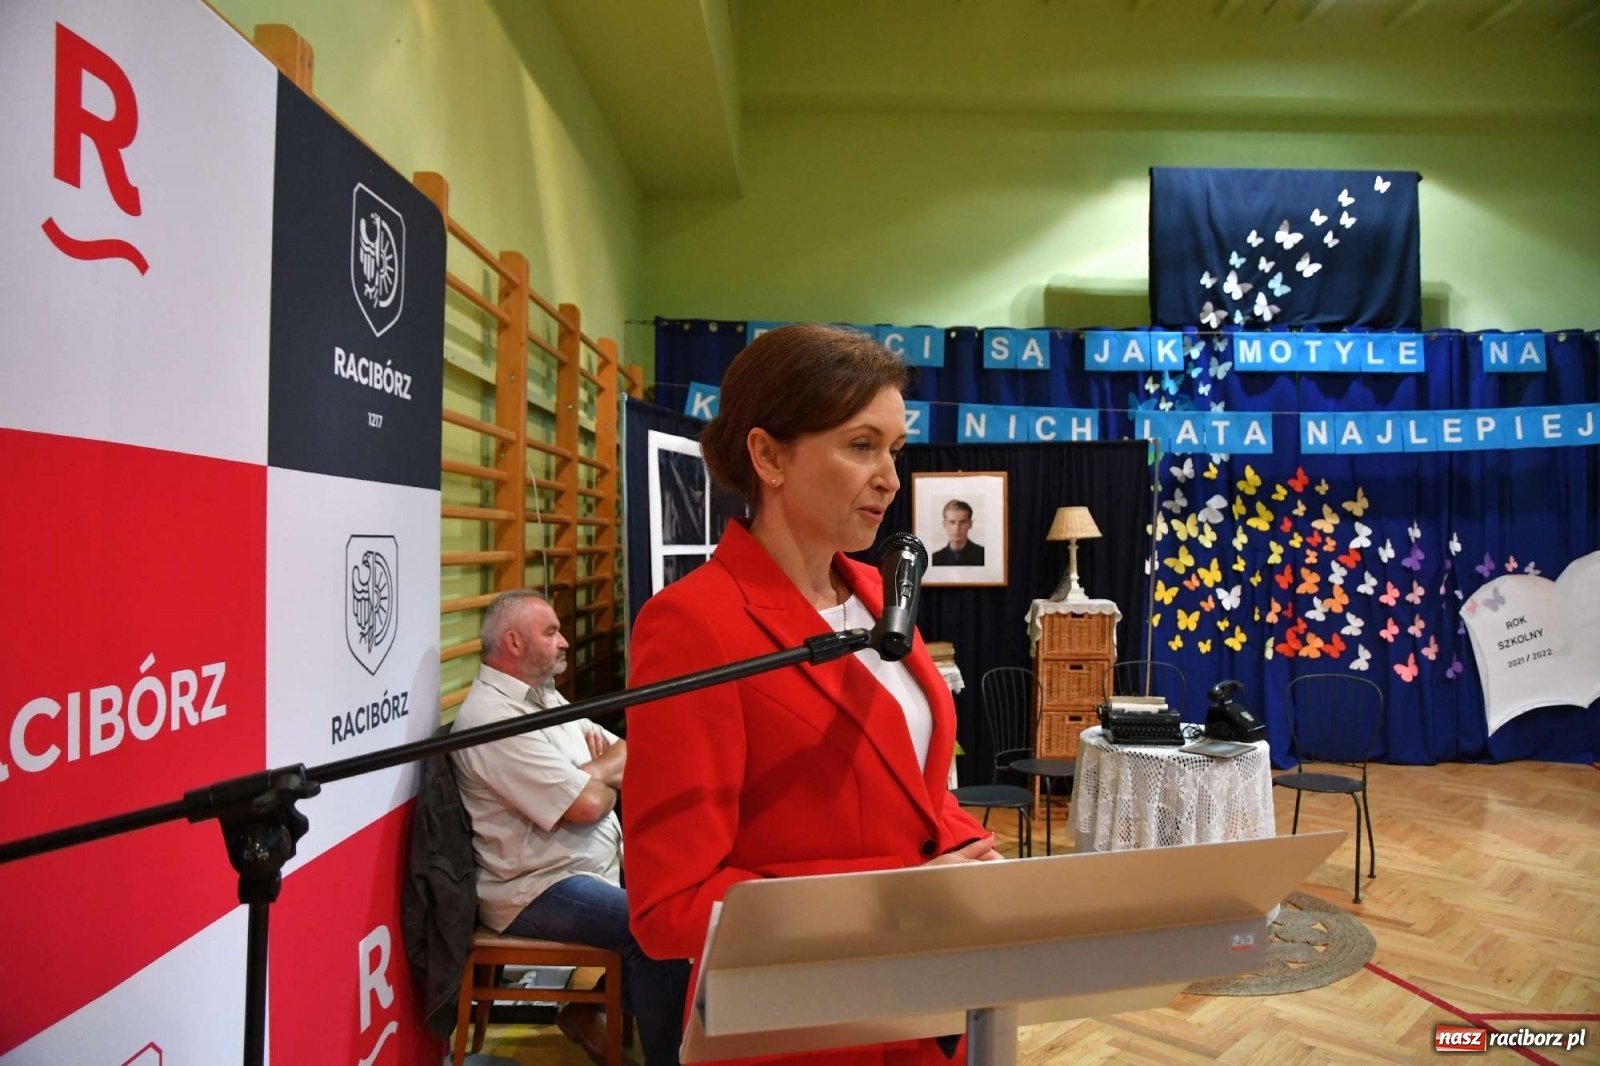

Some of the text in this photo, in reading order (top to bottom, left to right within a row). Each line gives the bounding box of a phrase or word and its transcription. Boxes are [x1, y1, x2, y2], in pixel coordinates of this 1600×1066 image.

[54, 21, 142, 217] R
[990, 337, 1541, 367] SĄ JAK MOTYLE NA
[334, 346, 412, 400] RACIBÓRZ
[368, 412, 383, 429] 1217
[965, 413, 1093, 441] NICH
[1307, 412, 1594, 446] NAJLEPIEJ
[1497, 629, 1543, 650] SZKOLNY
[1506, 616, 1527, 629] ROK
[1508, 658, 1525, 668] 2021
[1532, 649, 1552, 660] 2022
[0, 652, 227, 782] CIBÓRZ
[331, 689, 409, 745] RACIBÓRZ
[358, 924, 394, 1033] R
